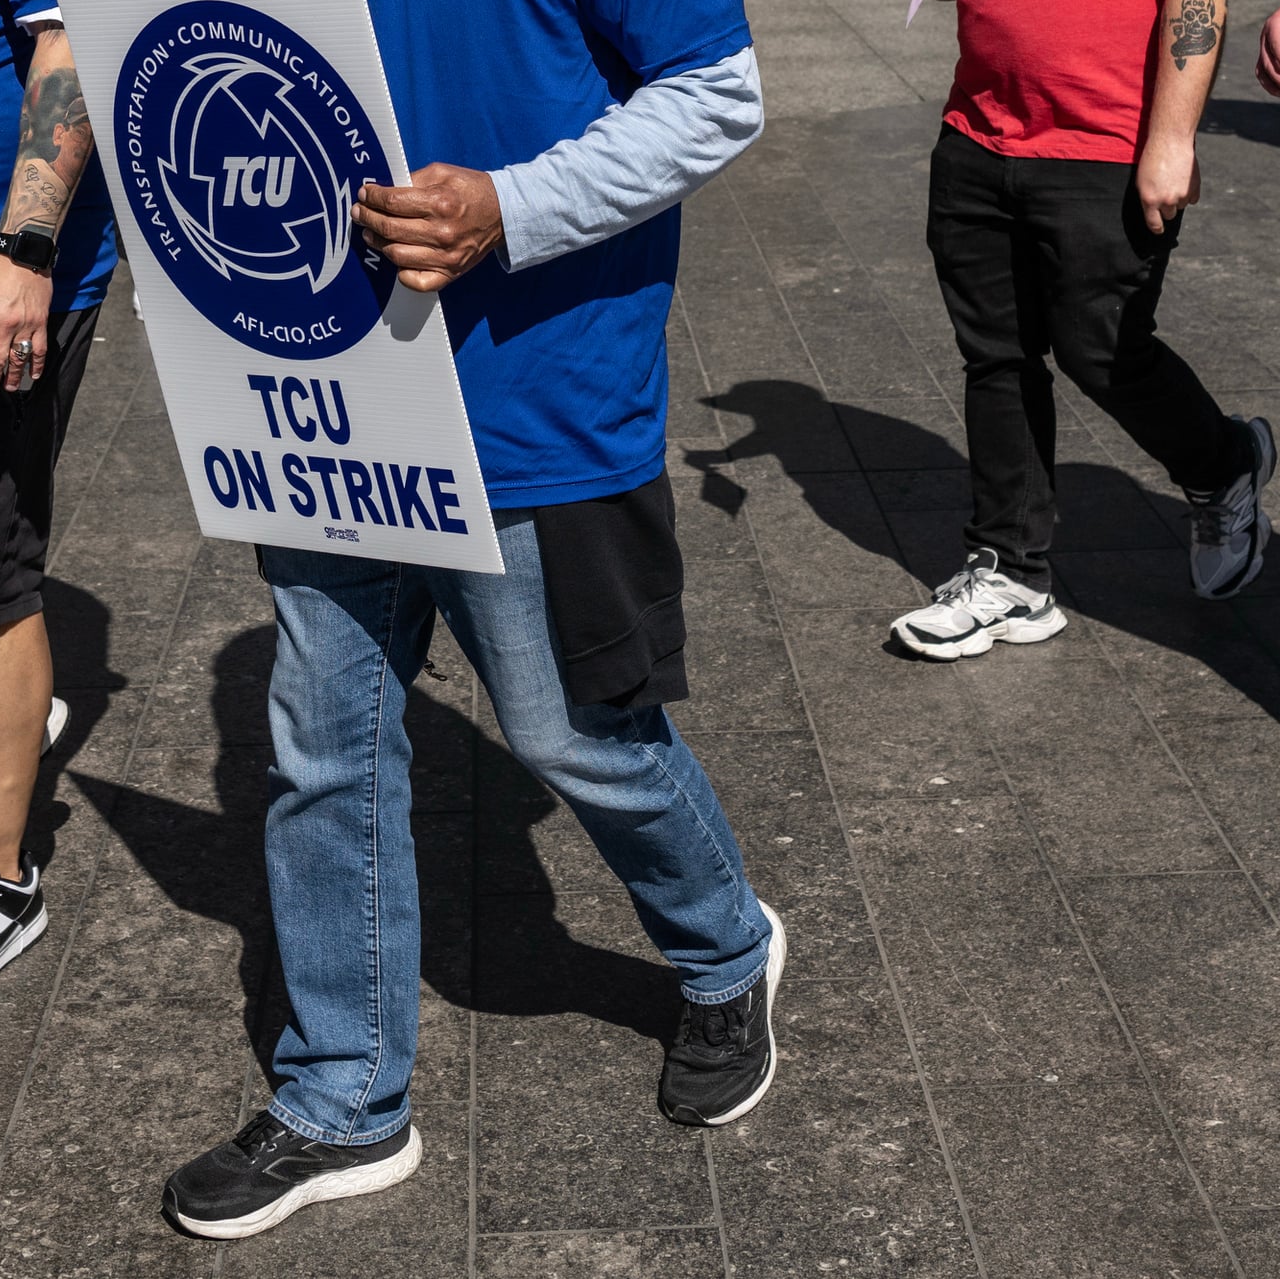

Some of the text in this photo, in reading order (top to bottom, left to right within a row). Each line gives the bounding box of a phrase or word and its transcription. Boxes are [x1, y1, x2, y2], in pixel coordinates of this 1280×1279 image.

[127, 41, 182, 262] TRANSPORTATION
[176, 20, 372, 166] COMMUNICATIONS
[222, 155, 297, 208] TCU
[246, 373, 353, 442] TCU
[201, 445, 470, 535] ON STRIKE
